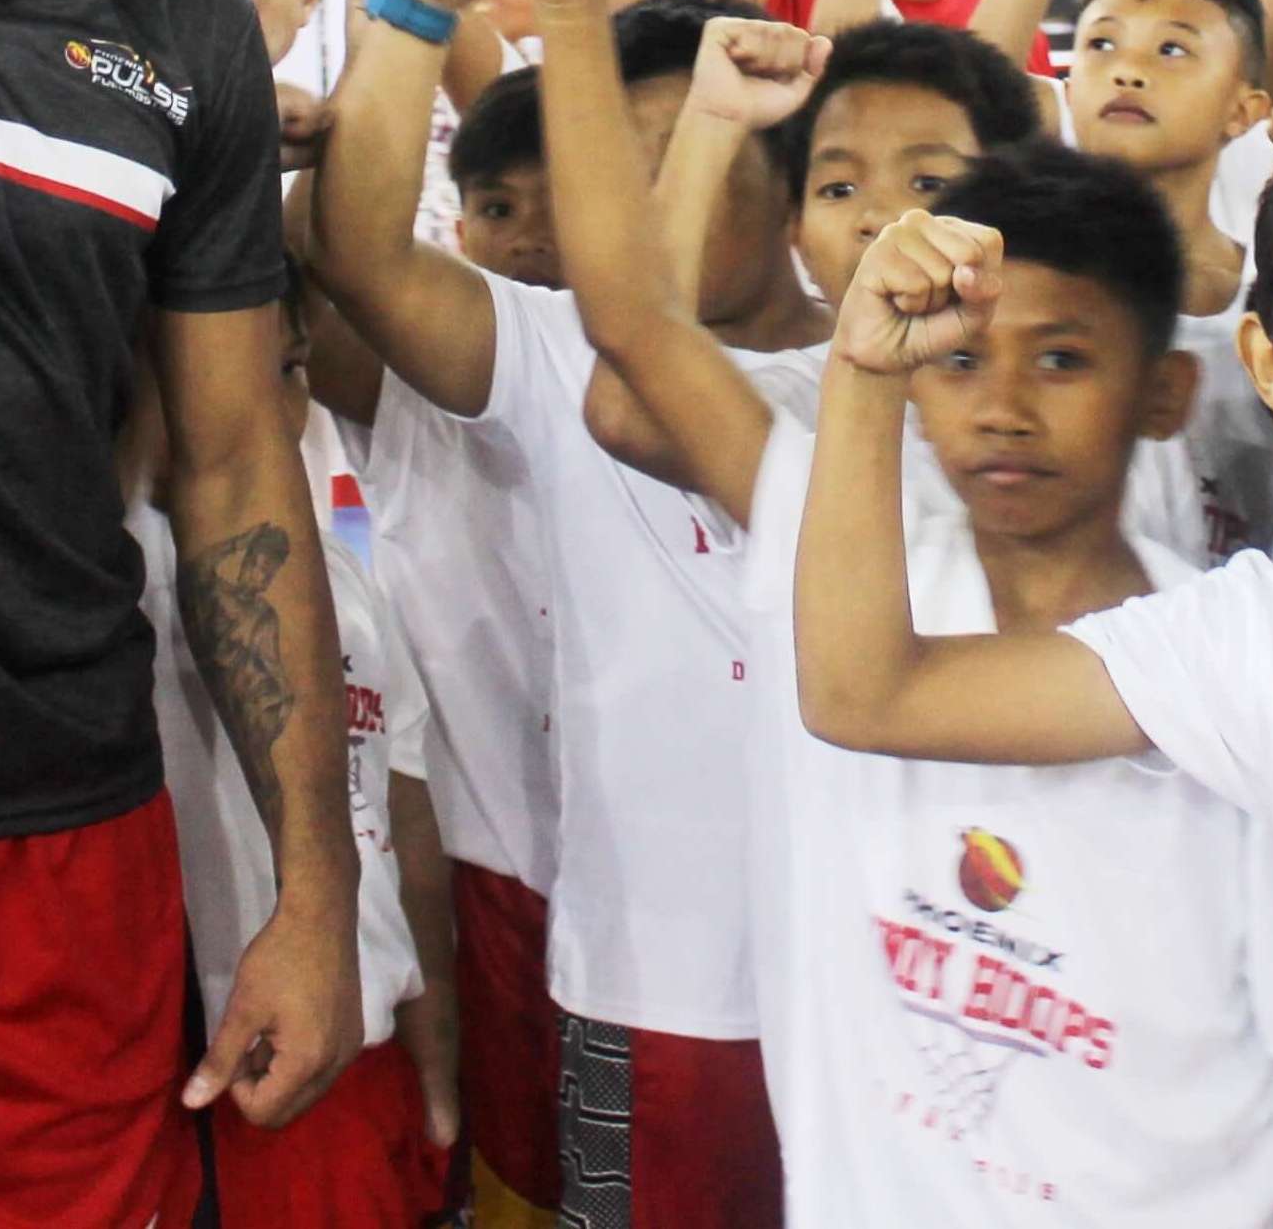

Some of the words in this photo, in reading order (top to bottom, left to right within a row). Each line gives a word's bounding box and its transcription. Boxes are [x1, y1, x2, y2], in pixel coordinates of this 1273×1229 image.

[90, 54, 189, 118] PULSE
[904, 888, 1065, 971] PHOENIX
[963, 954, 1117, 1070] HOOPS
